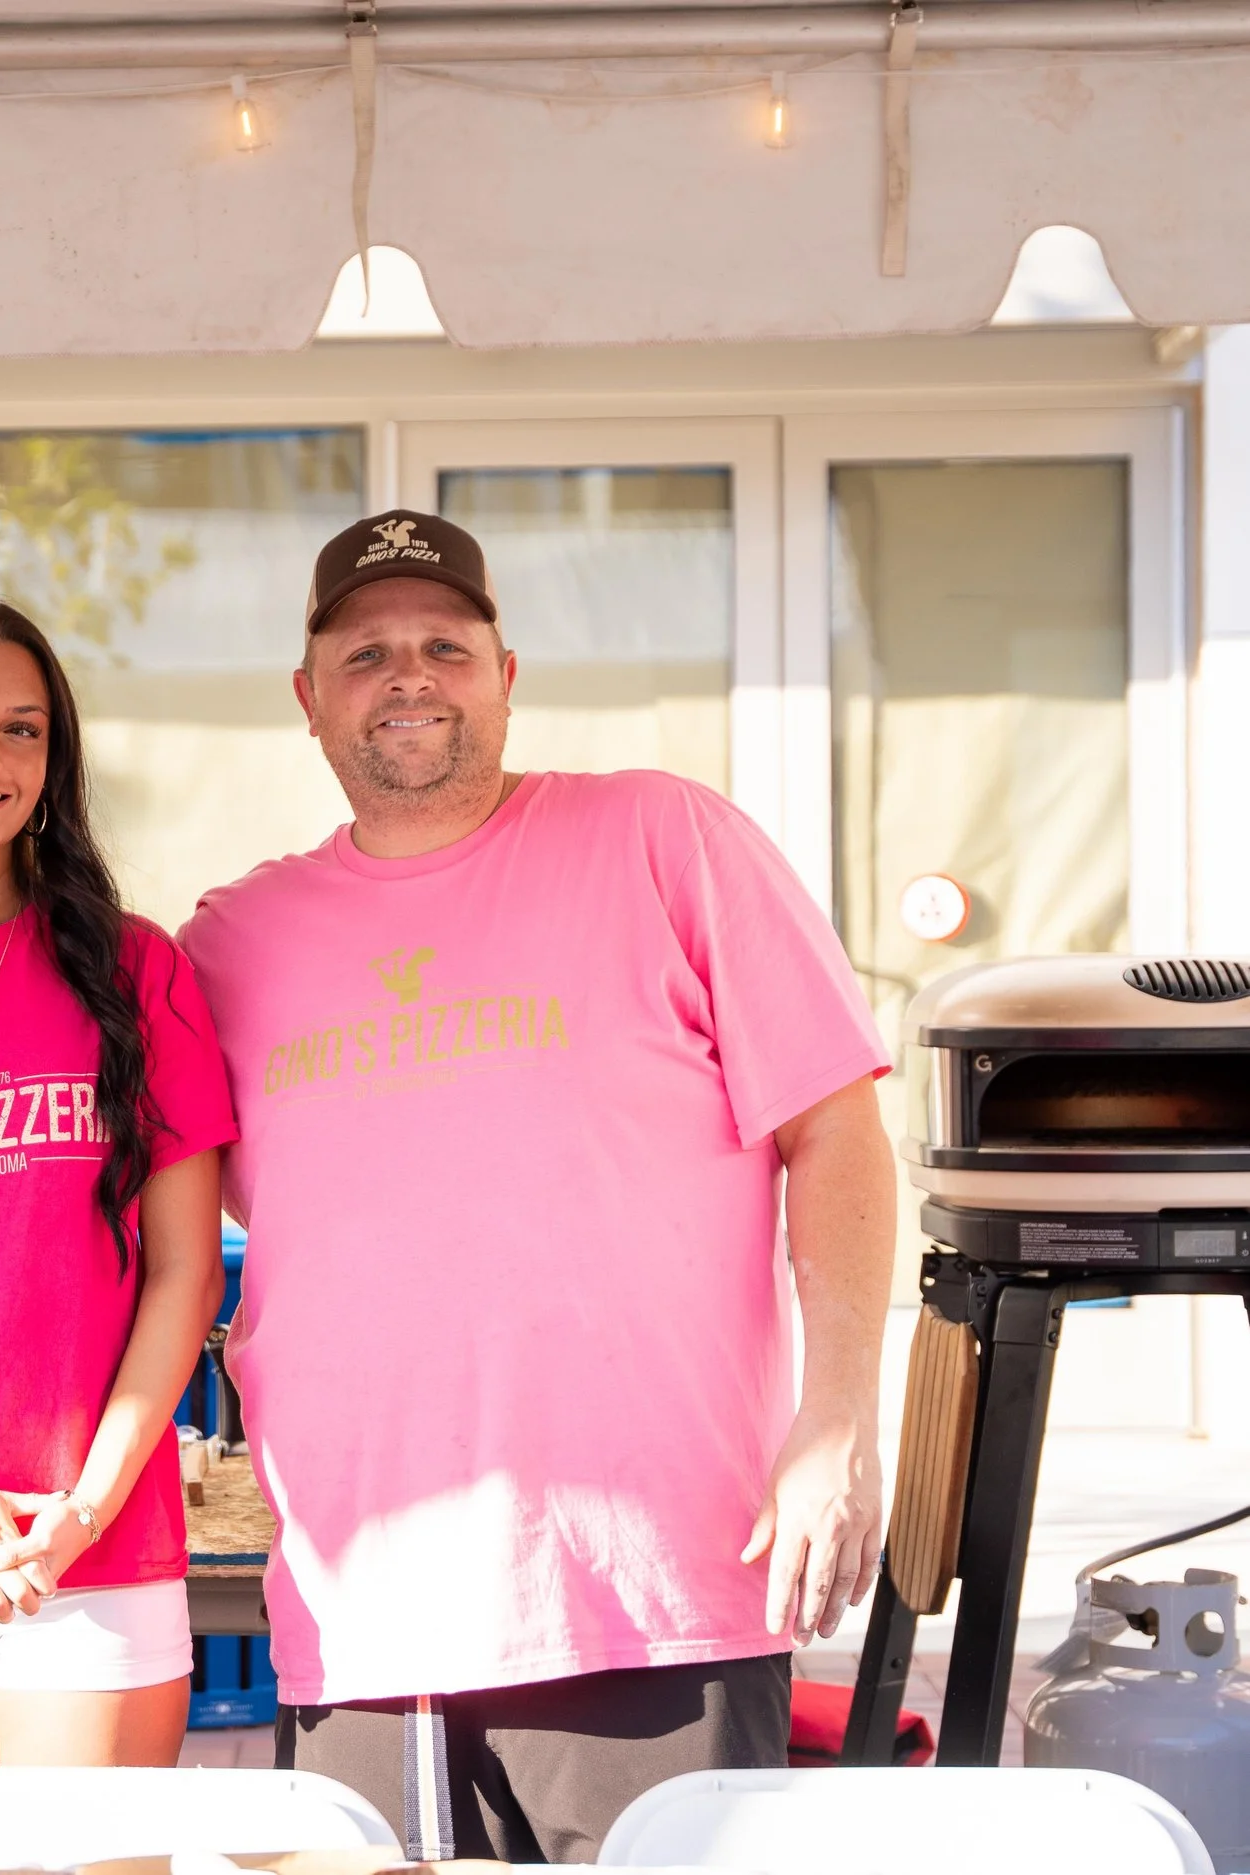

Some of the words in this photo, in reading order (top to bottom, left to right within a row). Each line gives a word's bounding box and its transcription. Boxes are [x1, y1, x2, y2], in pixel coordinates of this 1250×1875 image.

[355, 547, 399, 568] GINO'S
[400, 548, 441, 564] PIZZA
[367, 541, 389, 553] SINCE
[263, 1019, 378, 1096] GINO'S
[389, 995, 569, 1070] PIZZERIA
